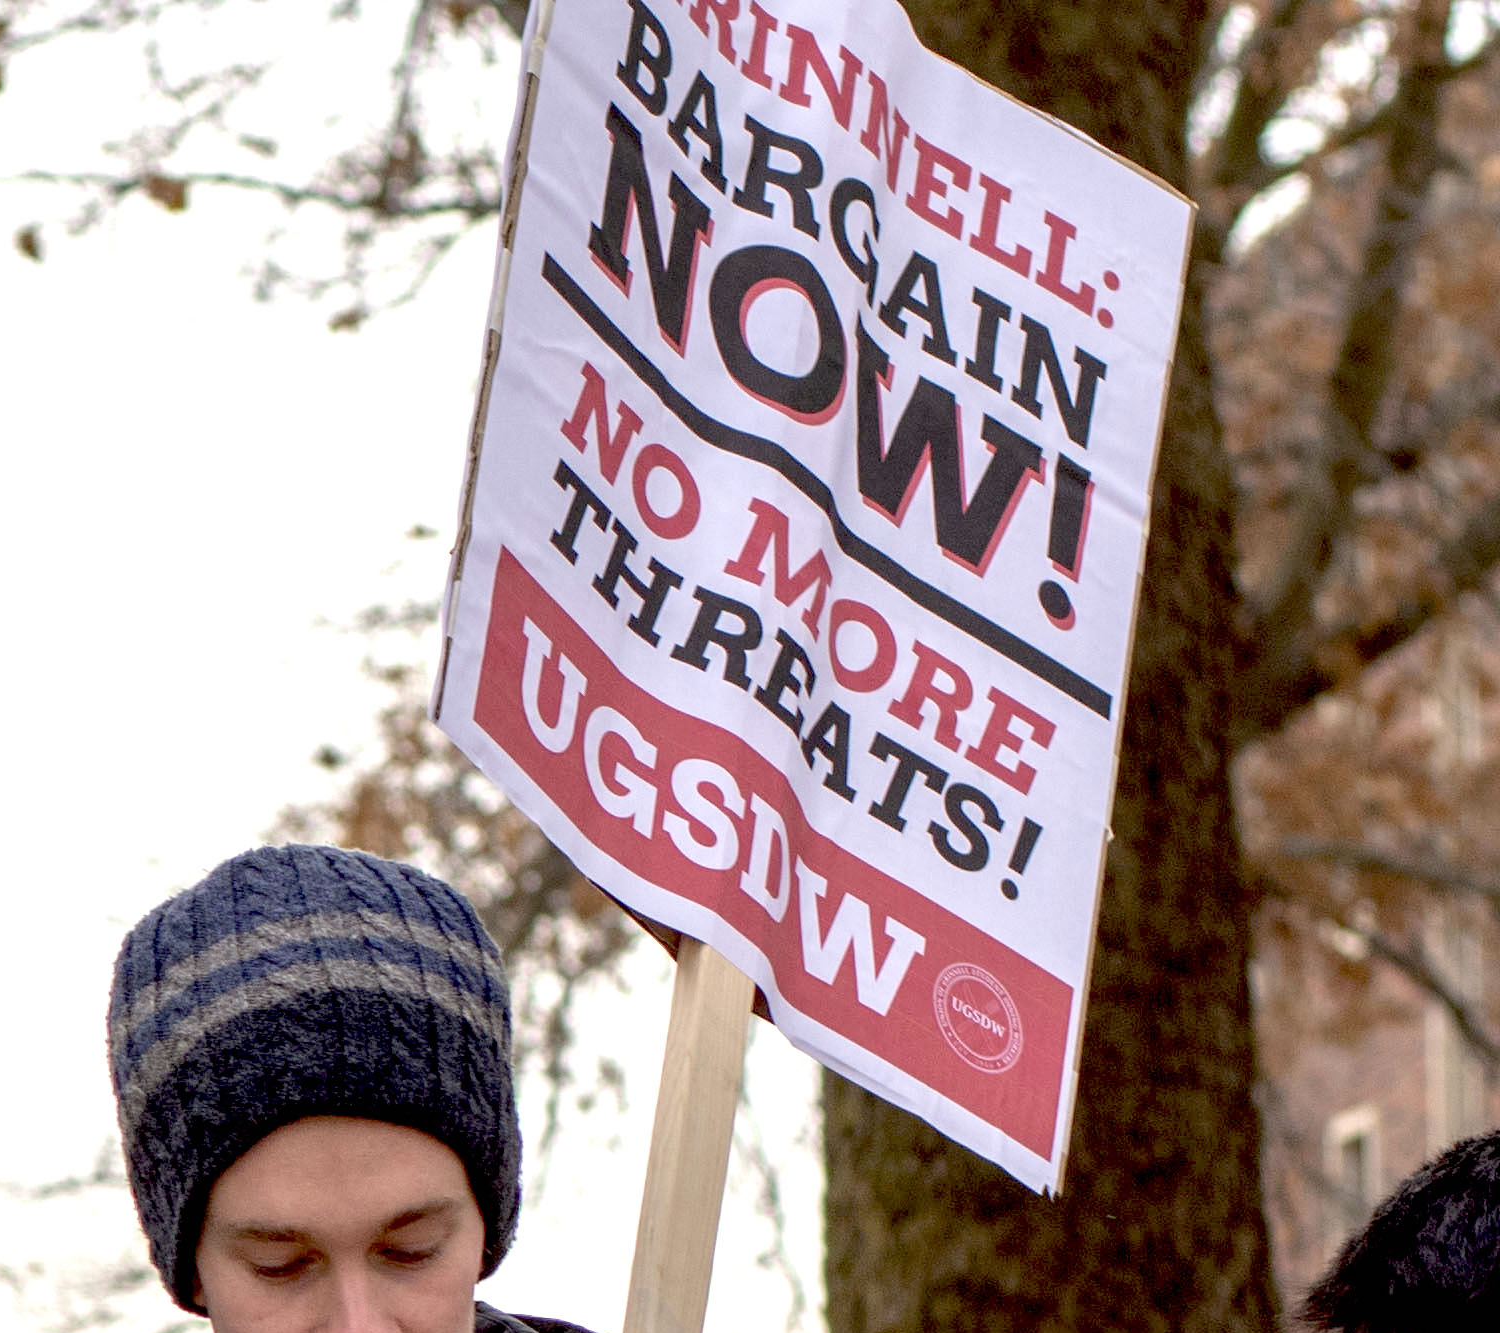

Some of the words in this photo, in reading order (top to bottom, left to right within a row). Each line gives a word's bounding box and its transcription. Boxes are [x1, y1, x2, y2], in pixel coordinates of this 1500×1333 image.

[588, 102, 1097, 631] NOW!
[617, 0, 1107, 450] BARGAIN
[672, 0, 1121, 328] RINNELL:
[548, 459, 1043, 902] THREATS!
[560, 361, 700, 541] NO
[724, 497, 1056, 796] MORE
[522, 617, 925, 1018] UGSDW
[951, 995, 1005, 1038] UGSDW
